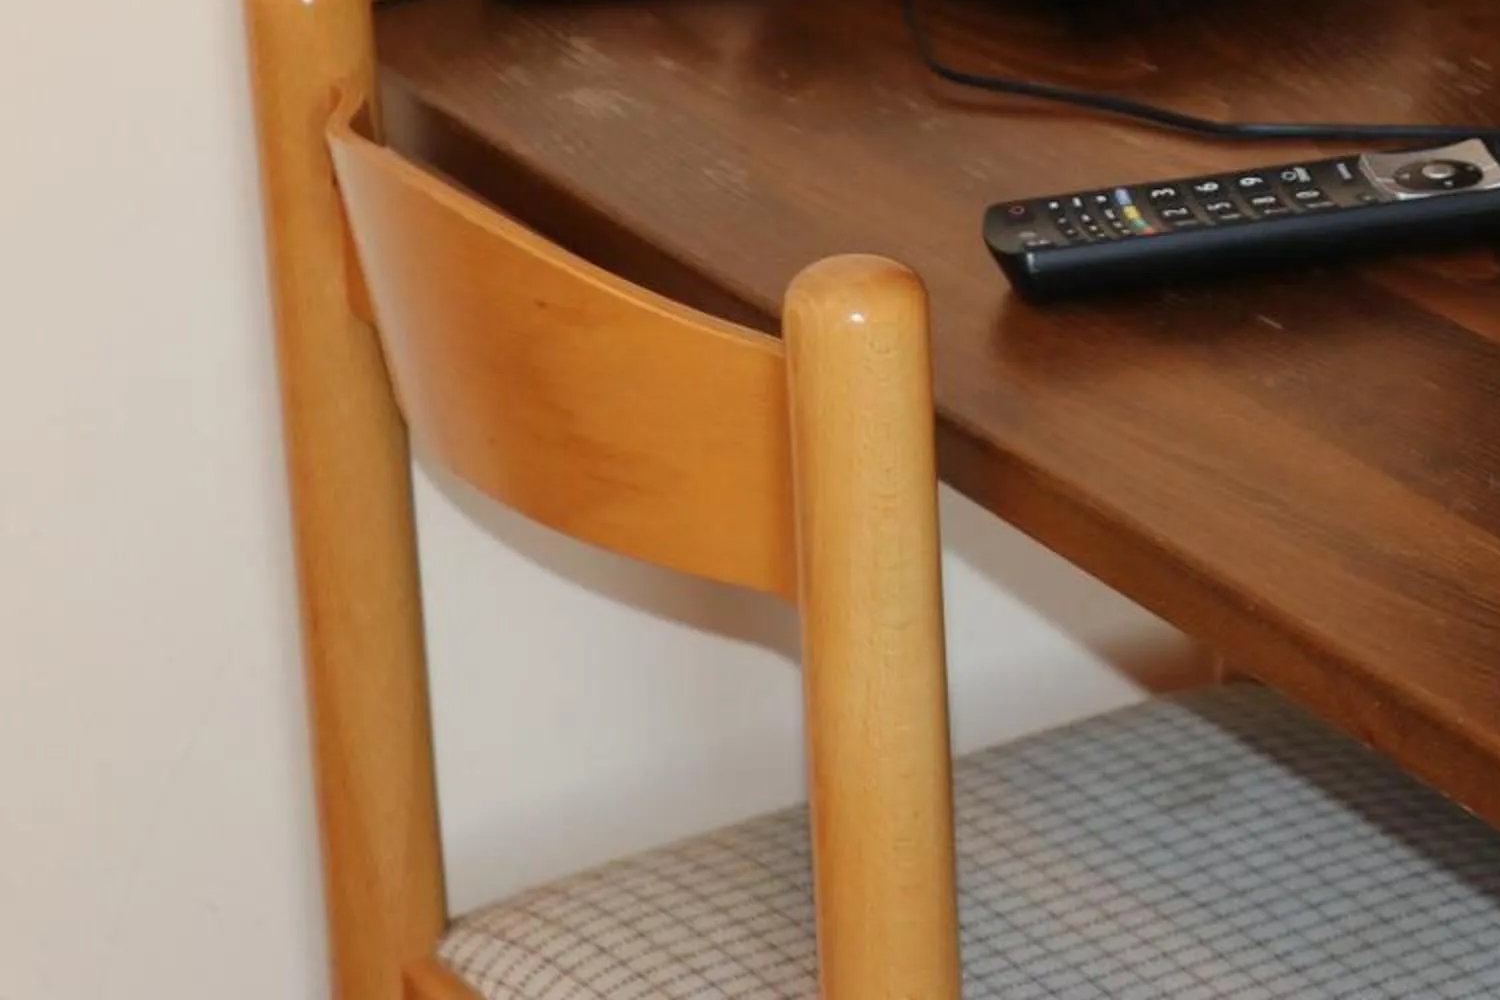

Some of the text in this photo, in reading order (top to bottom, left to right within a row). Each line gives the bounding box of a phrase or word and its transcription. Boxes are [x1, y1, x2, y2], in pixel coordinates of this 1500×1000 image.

[1240, 177, 1264, 186] 9
[1194, 182, 1219, 192] 6
[1151, 188, 1175, 198] 3
